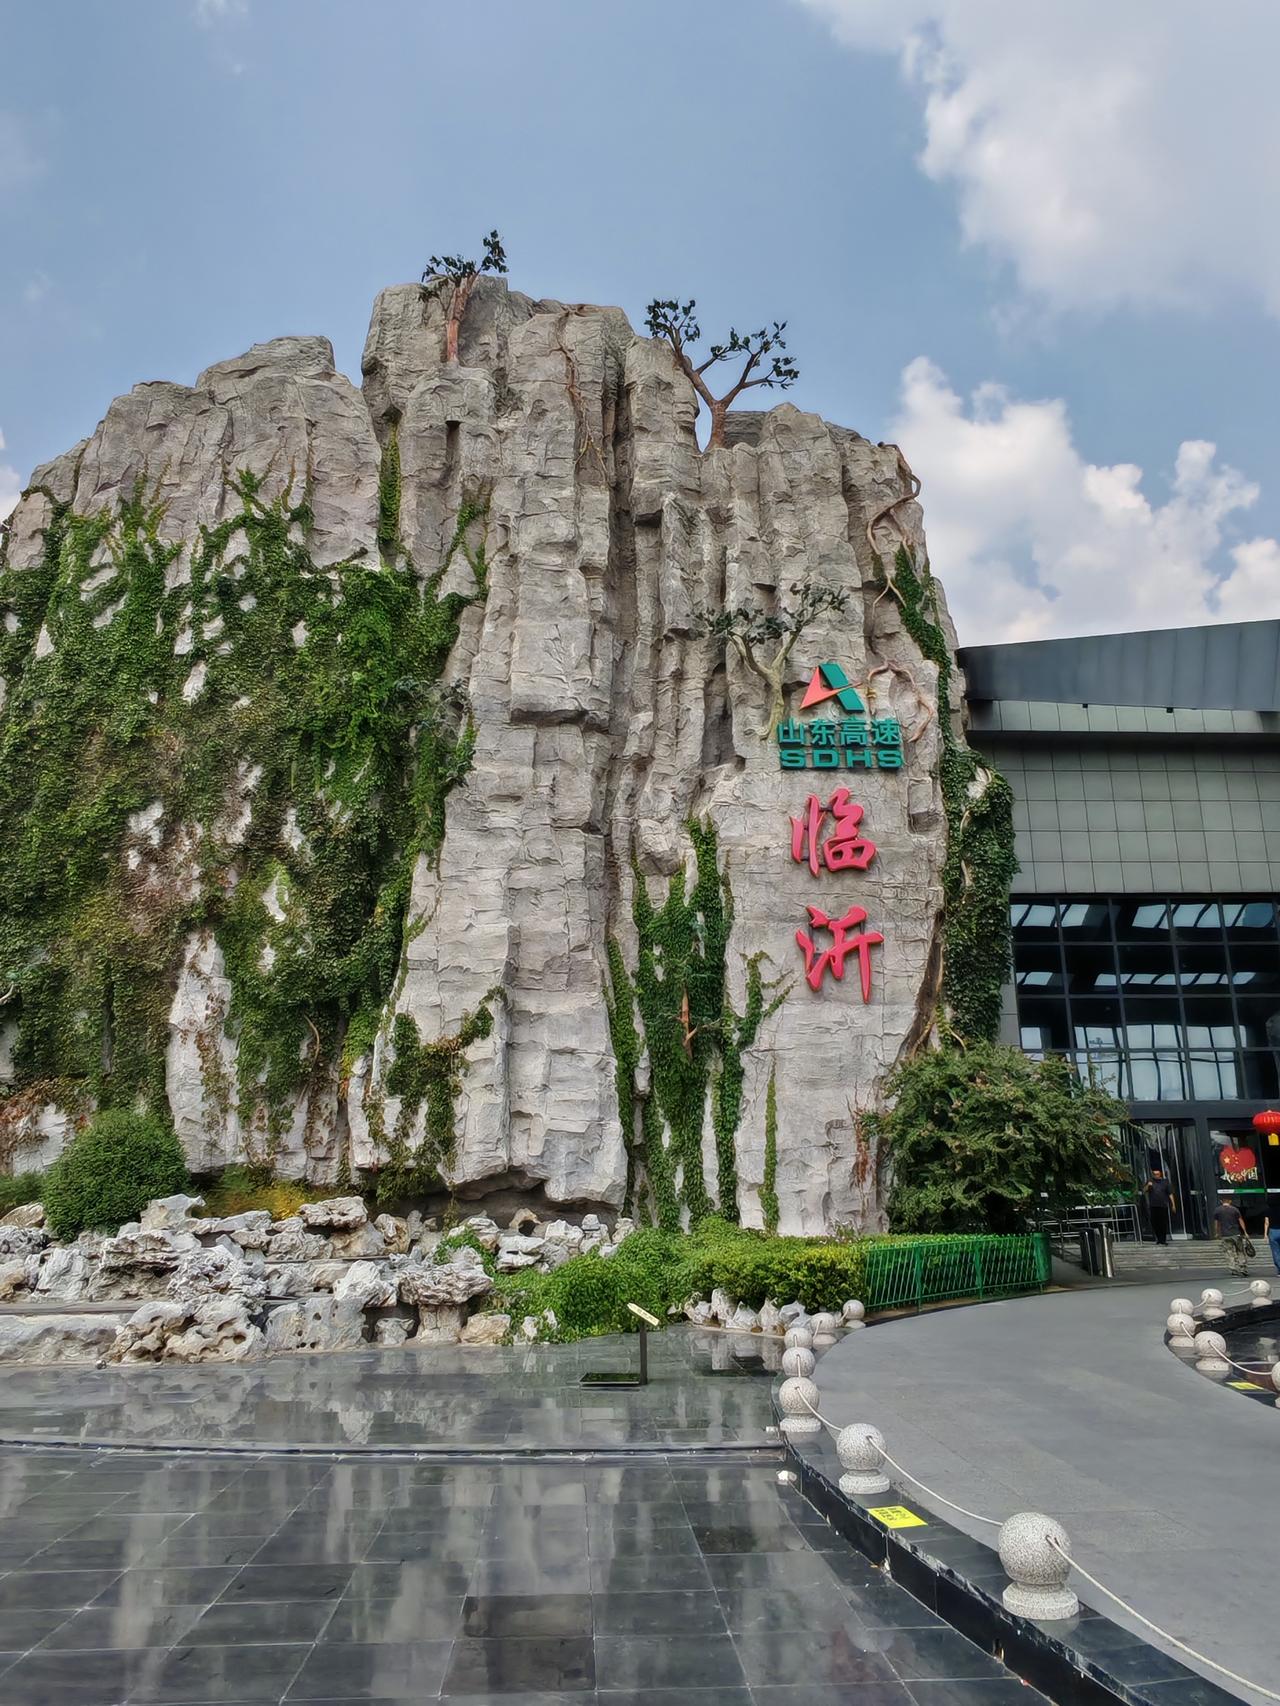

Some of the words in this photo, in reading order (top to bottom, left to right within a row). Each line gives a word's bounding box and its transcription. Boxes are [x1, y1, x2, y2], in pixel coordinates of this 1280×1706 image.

[777, 716, 901, 746] 山东高速
[780, 748, 903, 768] SDHS
[789, 787, 884, 1004] 临沂
